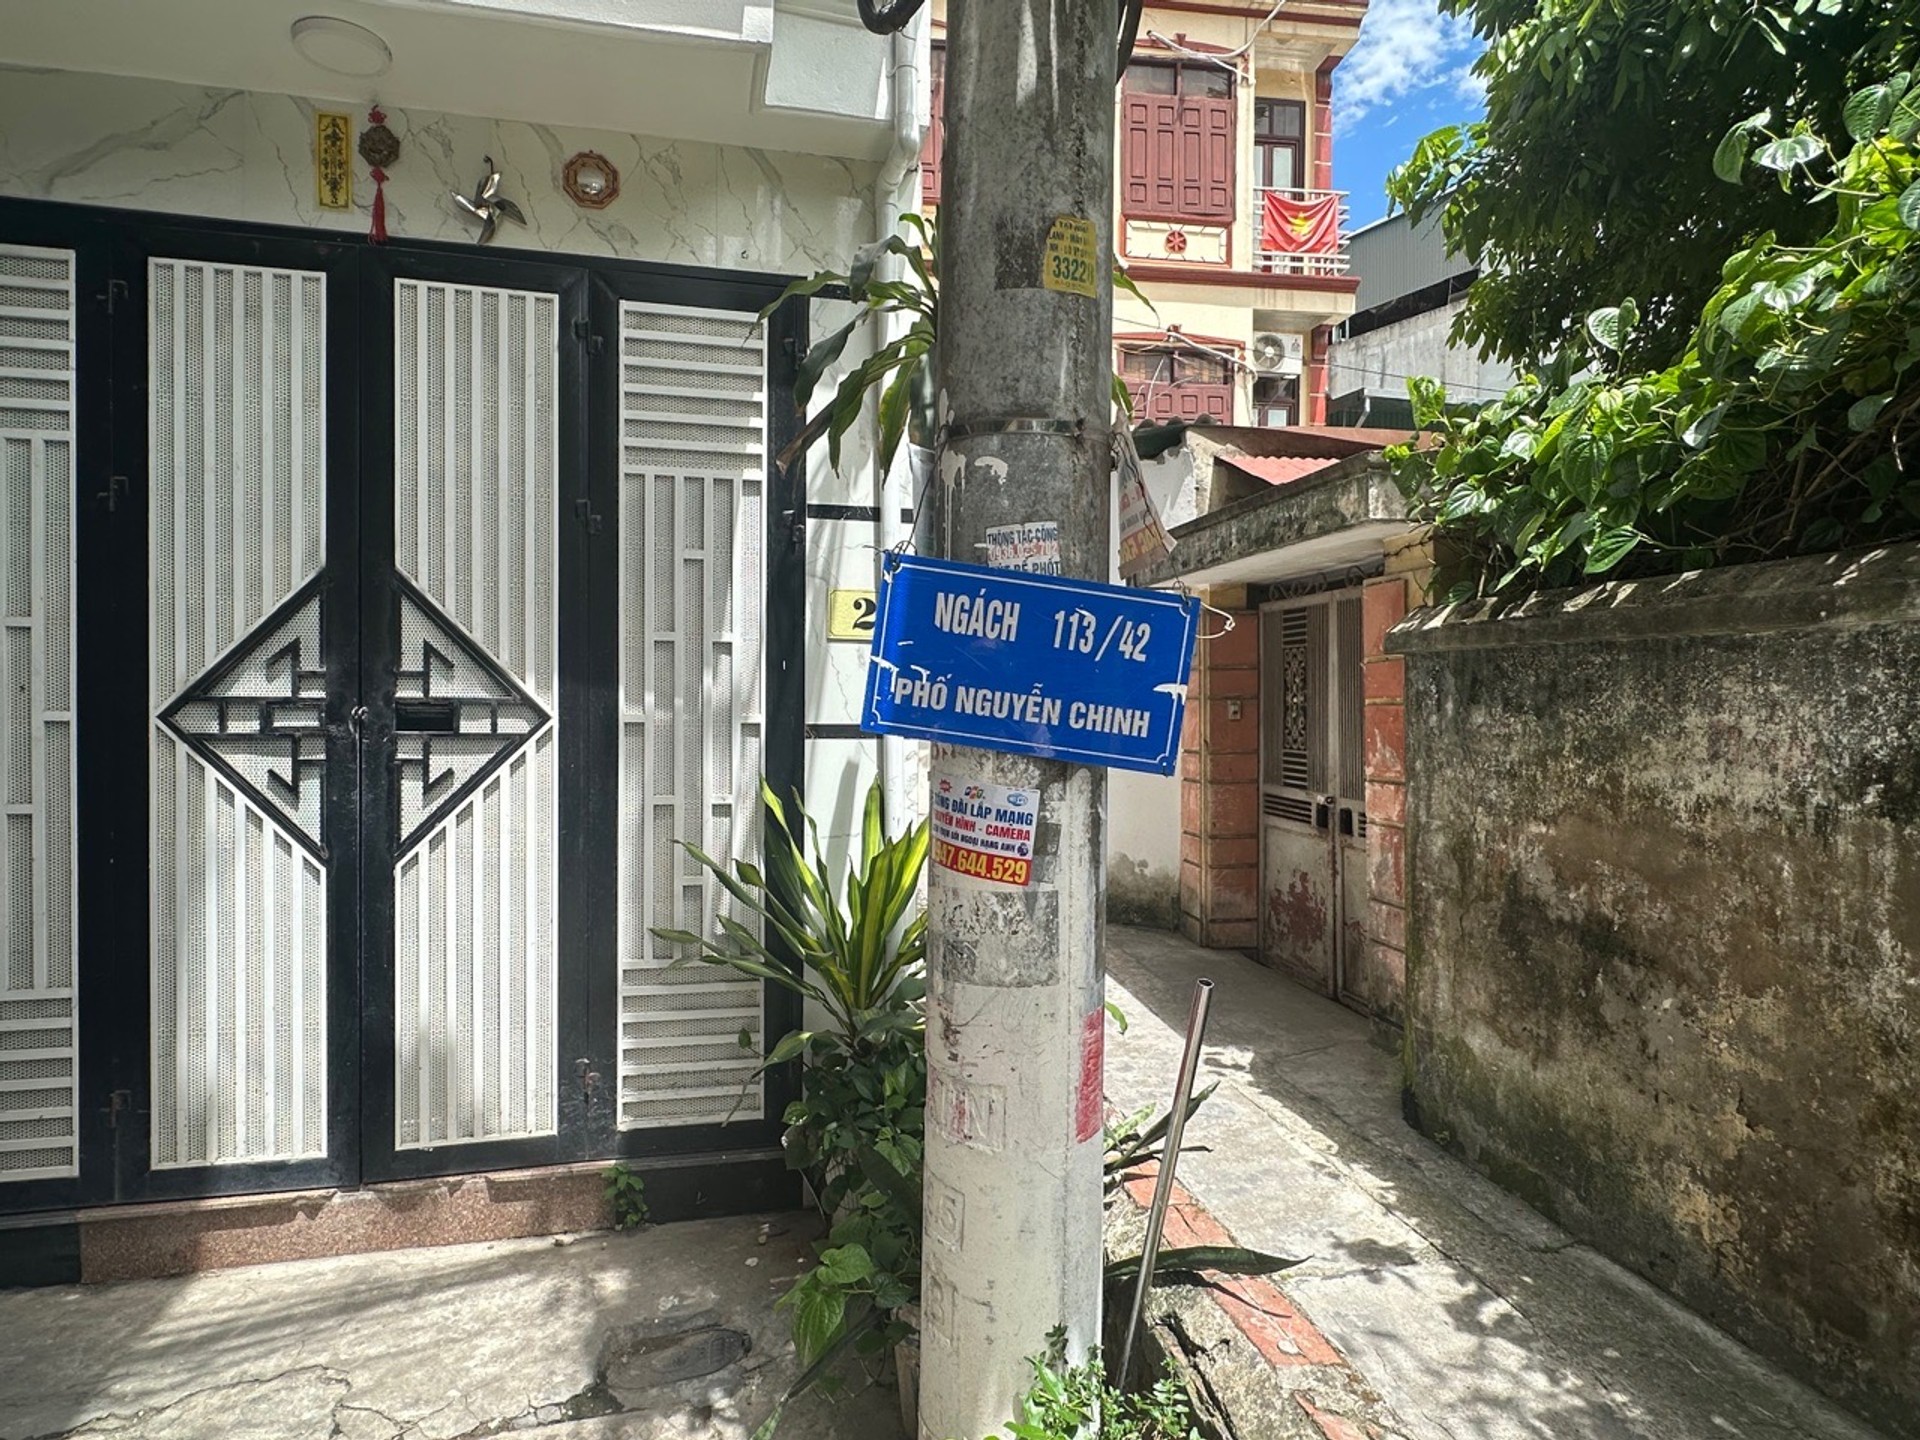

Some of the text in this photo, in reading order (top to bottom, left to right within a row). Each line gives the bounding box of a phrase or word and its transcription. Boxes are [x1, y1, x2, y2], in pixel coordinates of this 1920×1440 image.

[852, 597, 877, 630] 2
[933, 588, 1020, 642] NGÁCH
[894, 673, 1150, 738] PHỐ NGUYỄN CHINH
[951, 798, 968, 815] ĐÀI
[970, 800, 992, 819] LẮP
[995, 808, 1034, 827] MẠNG
[955, 815, 976, 832] HÌNH
[985, 824, 1031, 841] CAMERA
